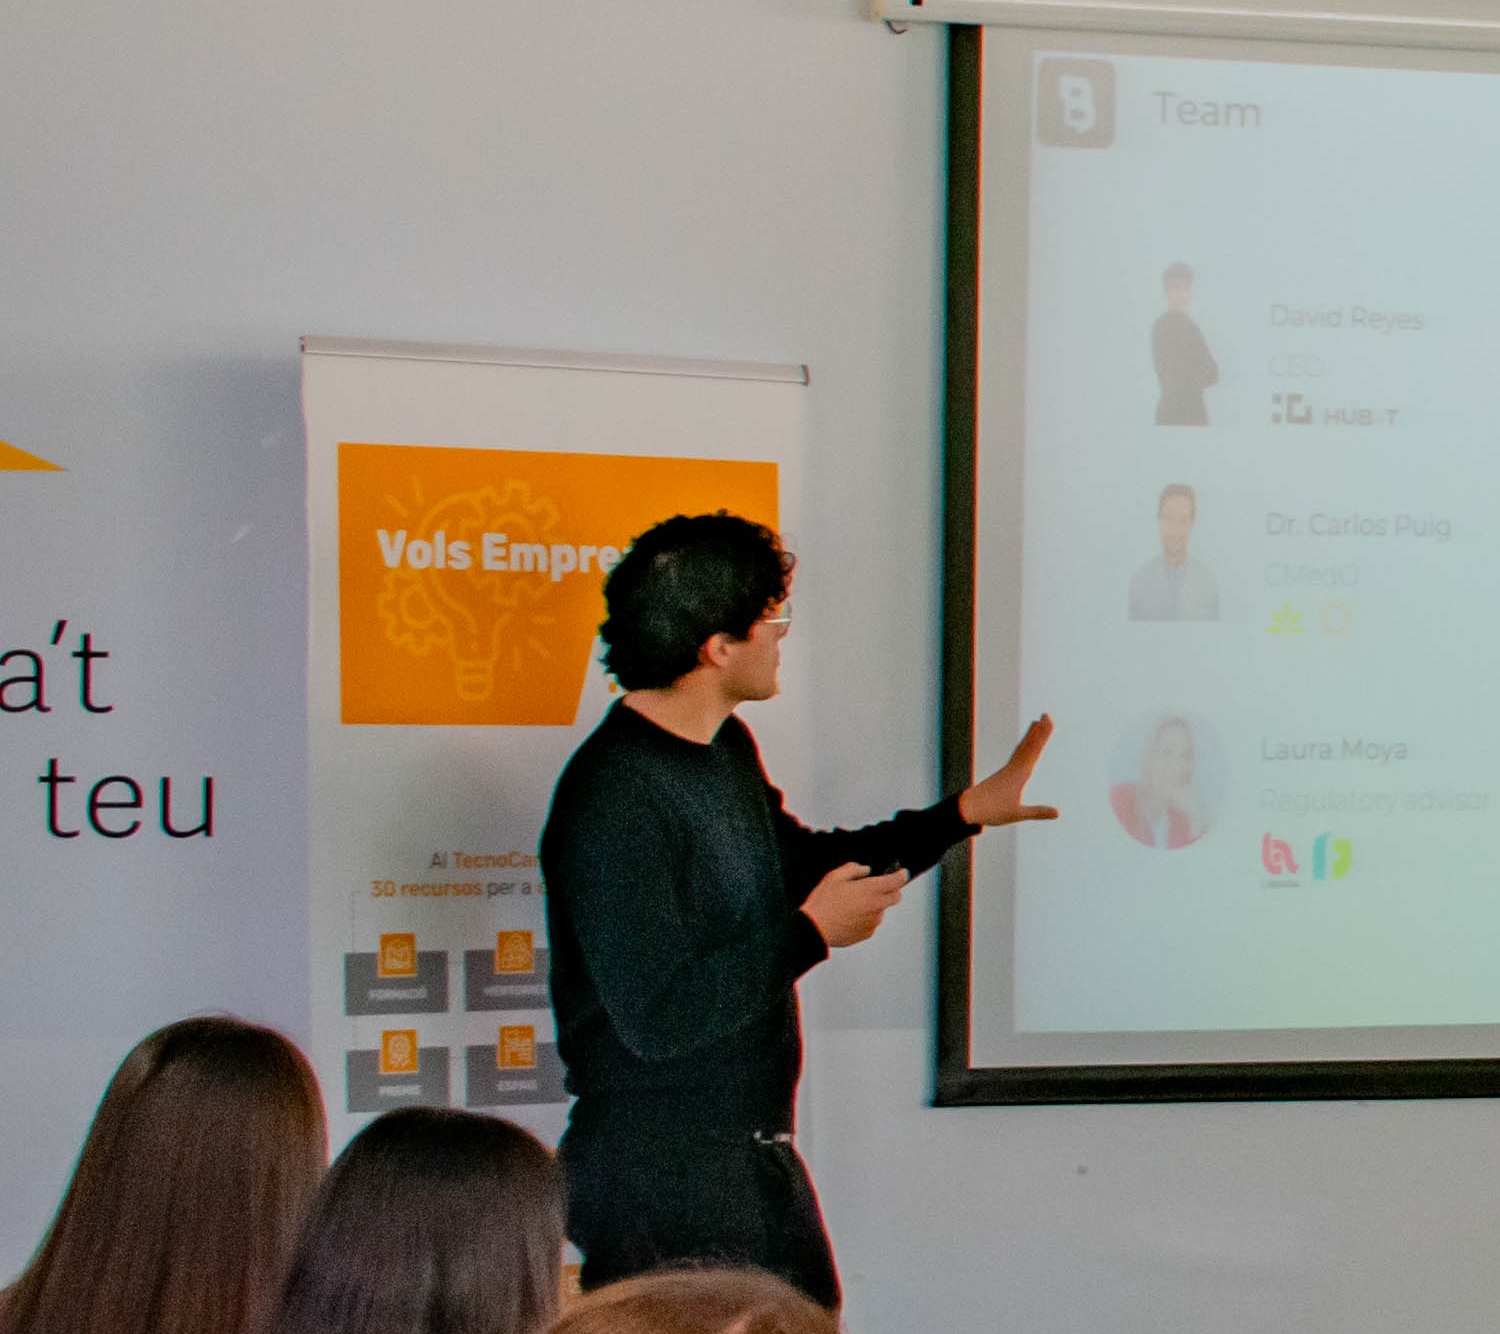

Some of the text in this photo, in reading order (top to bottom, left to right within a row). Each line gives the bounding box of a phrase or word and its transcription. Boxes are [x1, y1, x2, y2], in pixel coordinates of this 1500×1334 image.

[1152, 91, 1262, 128] Team
[1269, 303, 1425, 334] David Reyes
[1265, 512, 1453, 545] Dr. Carlos Puig
[377, 529, 629, 583] Vols Empre
[1261, 737, 1408, 767] Laura Moya
[38, 758, 215, 839] teu
[1258, 788, 1399, 817] Regulatory
[370, 880, 395, 898] 30
[401, 881, 483, 898] recursos
[487, 881, 516, 900] per
[521, 882, 533, 896] a
